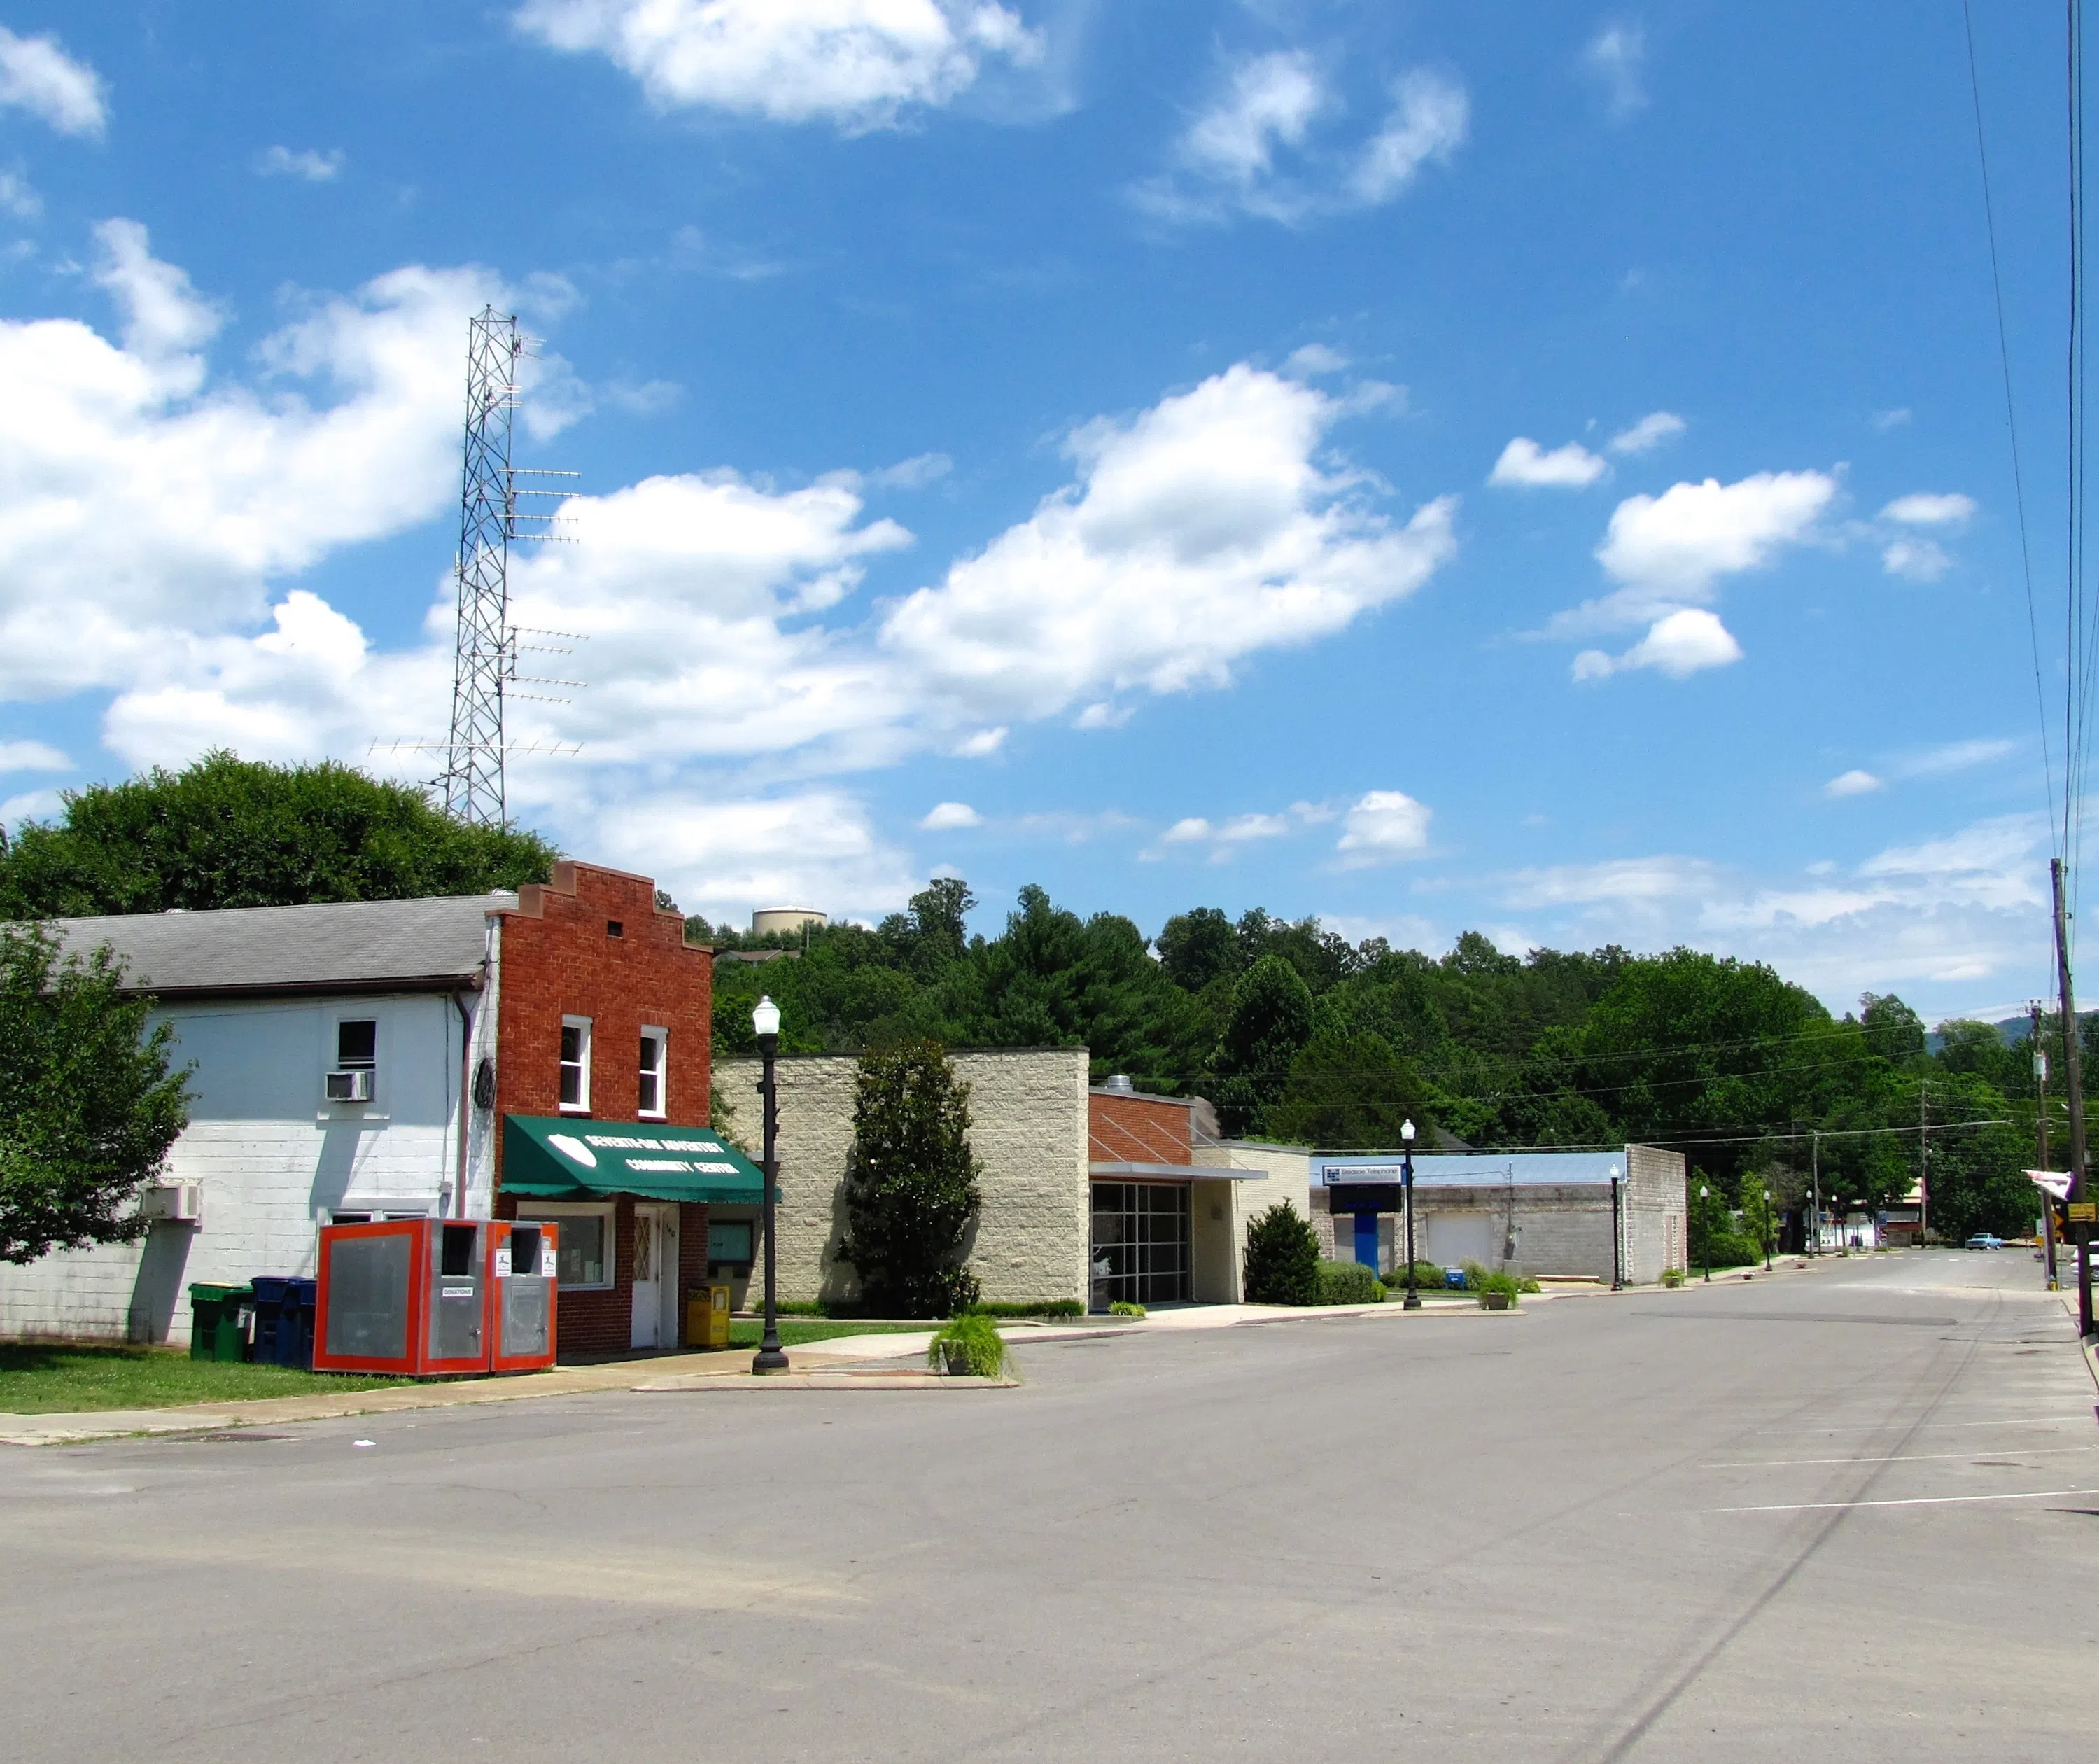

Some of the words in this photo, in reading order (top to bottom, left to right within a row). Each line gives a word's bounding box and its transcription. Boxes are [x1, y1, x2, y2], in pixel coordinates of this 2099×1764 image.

[660, 1140, 725, 1153] ADVENTIST
[625, 1158, 694, 1172] COMMUNITY
[693, 1162, 740, 1174] CENTER
